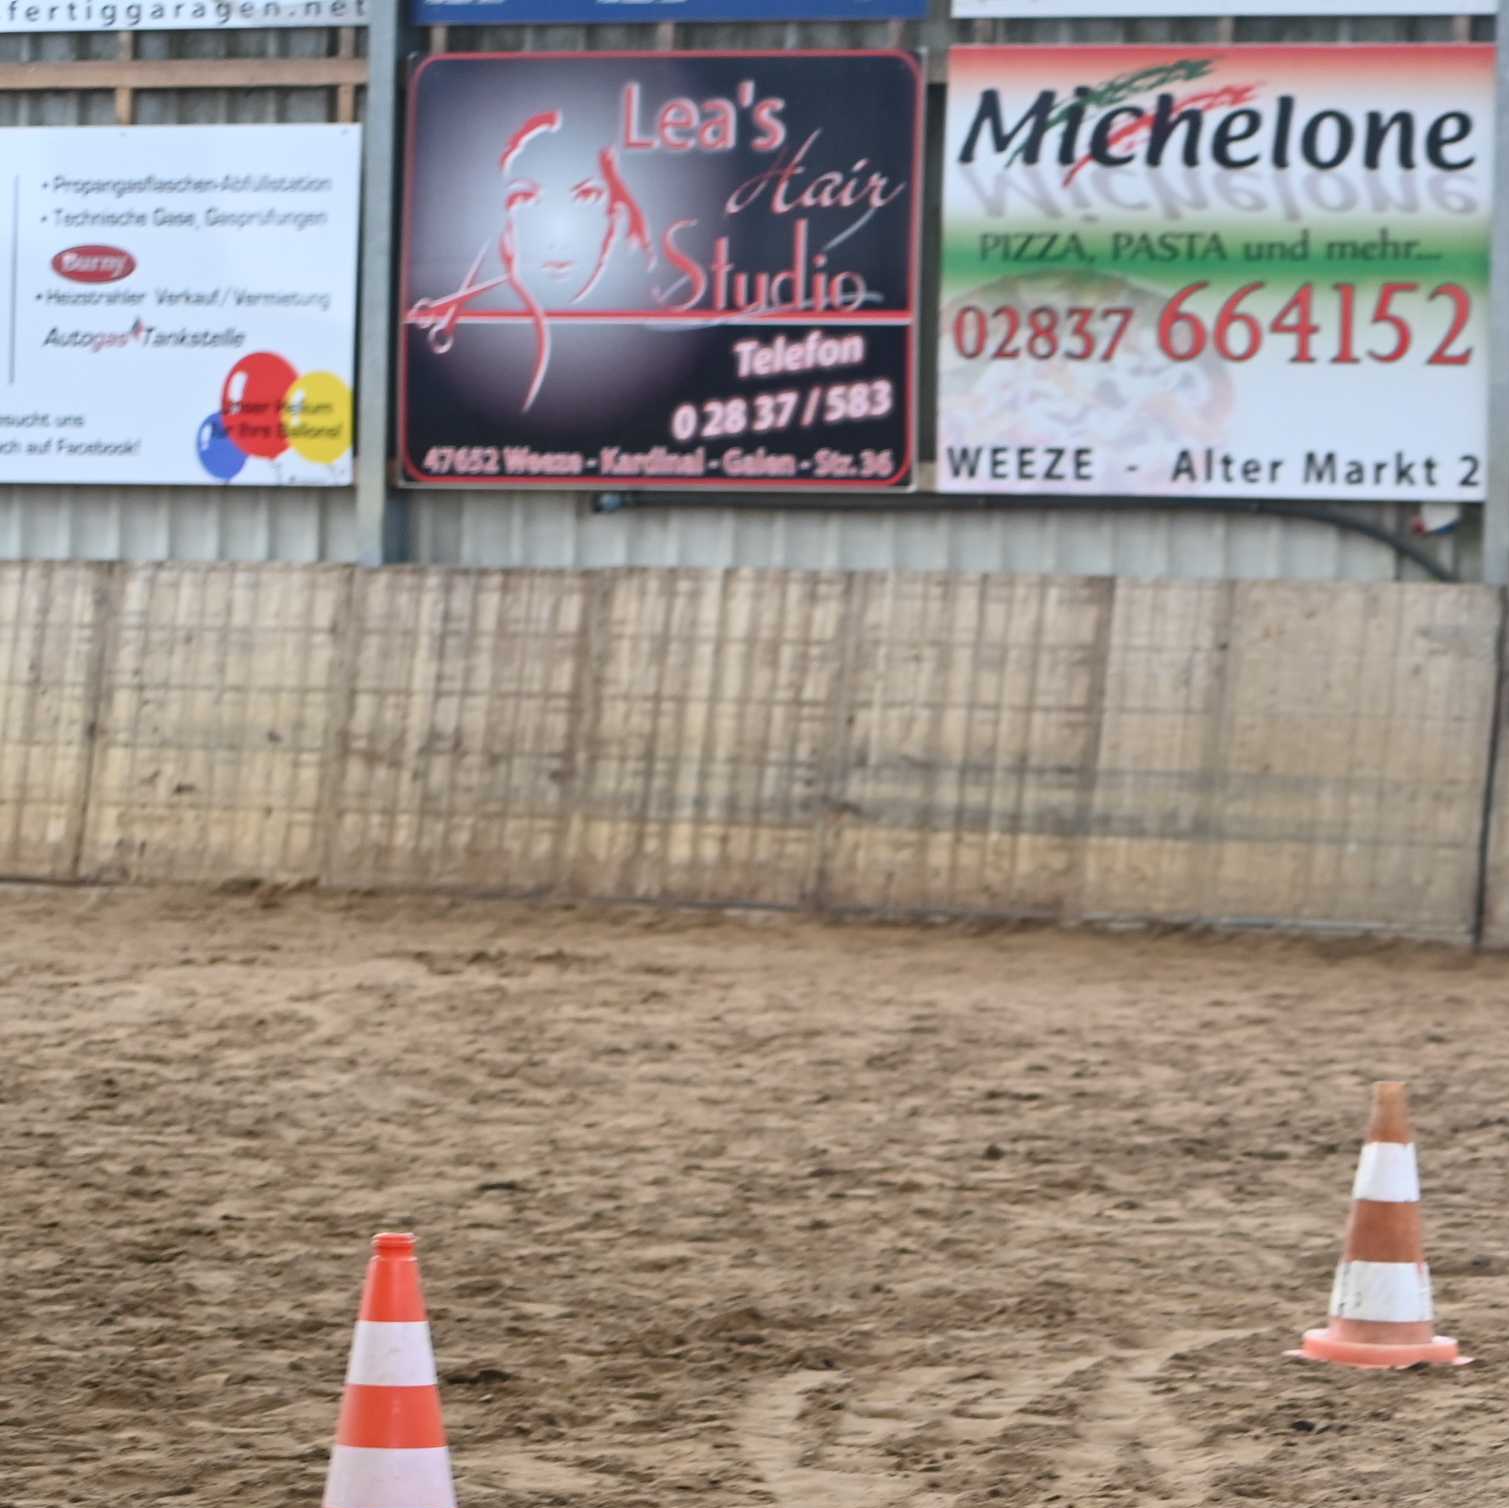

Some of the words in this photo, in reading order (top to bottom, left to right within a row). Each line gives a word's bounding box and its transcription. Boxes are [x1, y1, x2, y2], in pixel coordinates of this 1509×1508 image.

[622, 80, 787, 151] Lea's
[957, 85, 1478, 172] Michelone
[725, 127, 906, 217] Hair
[651, 218, 884, 313] Studio
[978, 232, 1097, 265] PIZZA,
[1111, 233, 1228, 262] PASTA
[1242, 229, 1311, 263] und
[1325, 228, 1442, 262] mehr...
[43, 327, 130, 351] Autogas
[143, 327, 247, 348] Tankstelle
[952, 305, 1134, 362] 02837
[1156, 280, 1475, 367] 664152
[733, 330, 864, 378] Telefon
[824, 379, 893, 425] 583
[503, 447, 583, 475] Weeze
[600, 447, 704, 476] Kardinal
[722, 448, 797, 476] Galen
[947, 446, 1094, 481] WEEZE
[1171, 449, 1285, 484] Alter
[1304, 451, 1440, 487] Markt
[1457, 455, 1481, 488] 2
